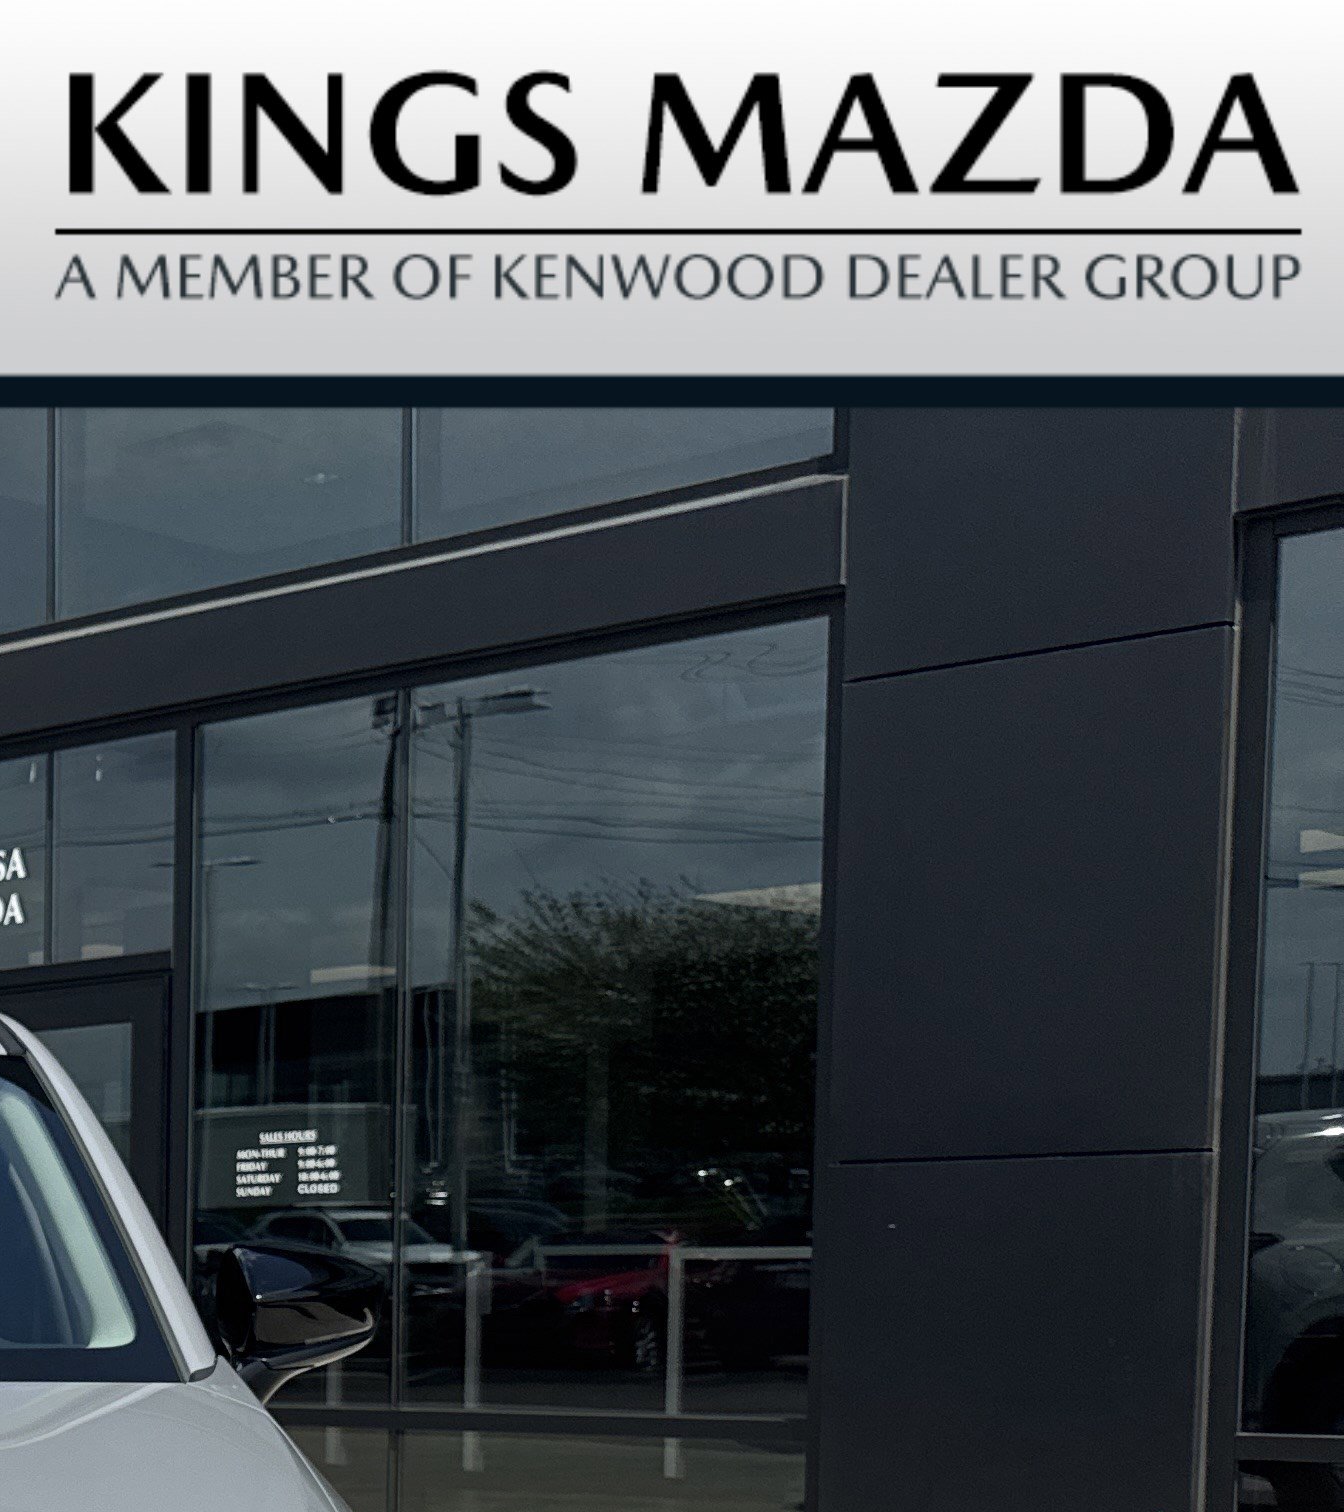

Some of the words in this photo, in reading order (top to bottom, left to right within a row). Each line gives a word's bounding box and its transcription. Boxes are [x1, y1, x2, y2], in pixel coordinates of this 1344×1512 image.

[236, 1161, 267, 1172] FRIDAY
[236, 1173, 282, 1185] SATURDAY
[236, 1185, 272, 1197] SUNDAY
[297, 1182, 339, 1194] CLOSED
